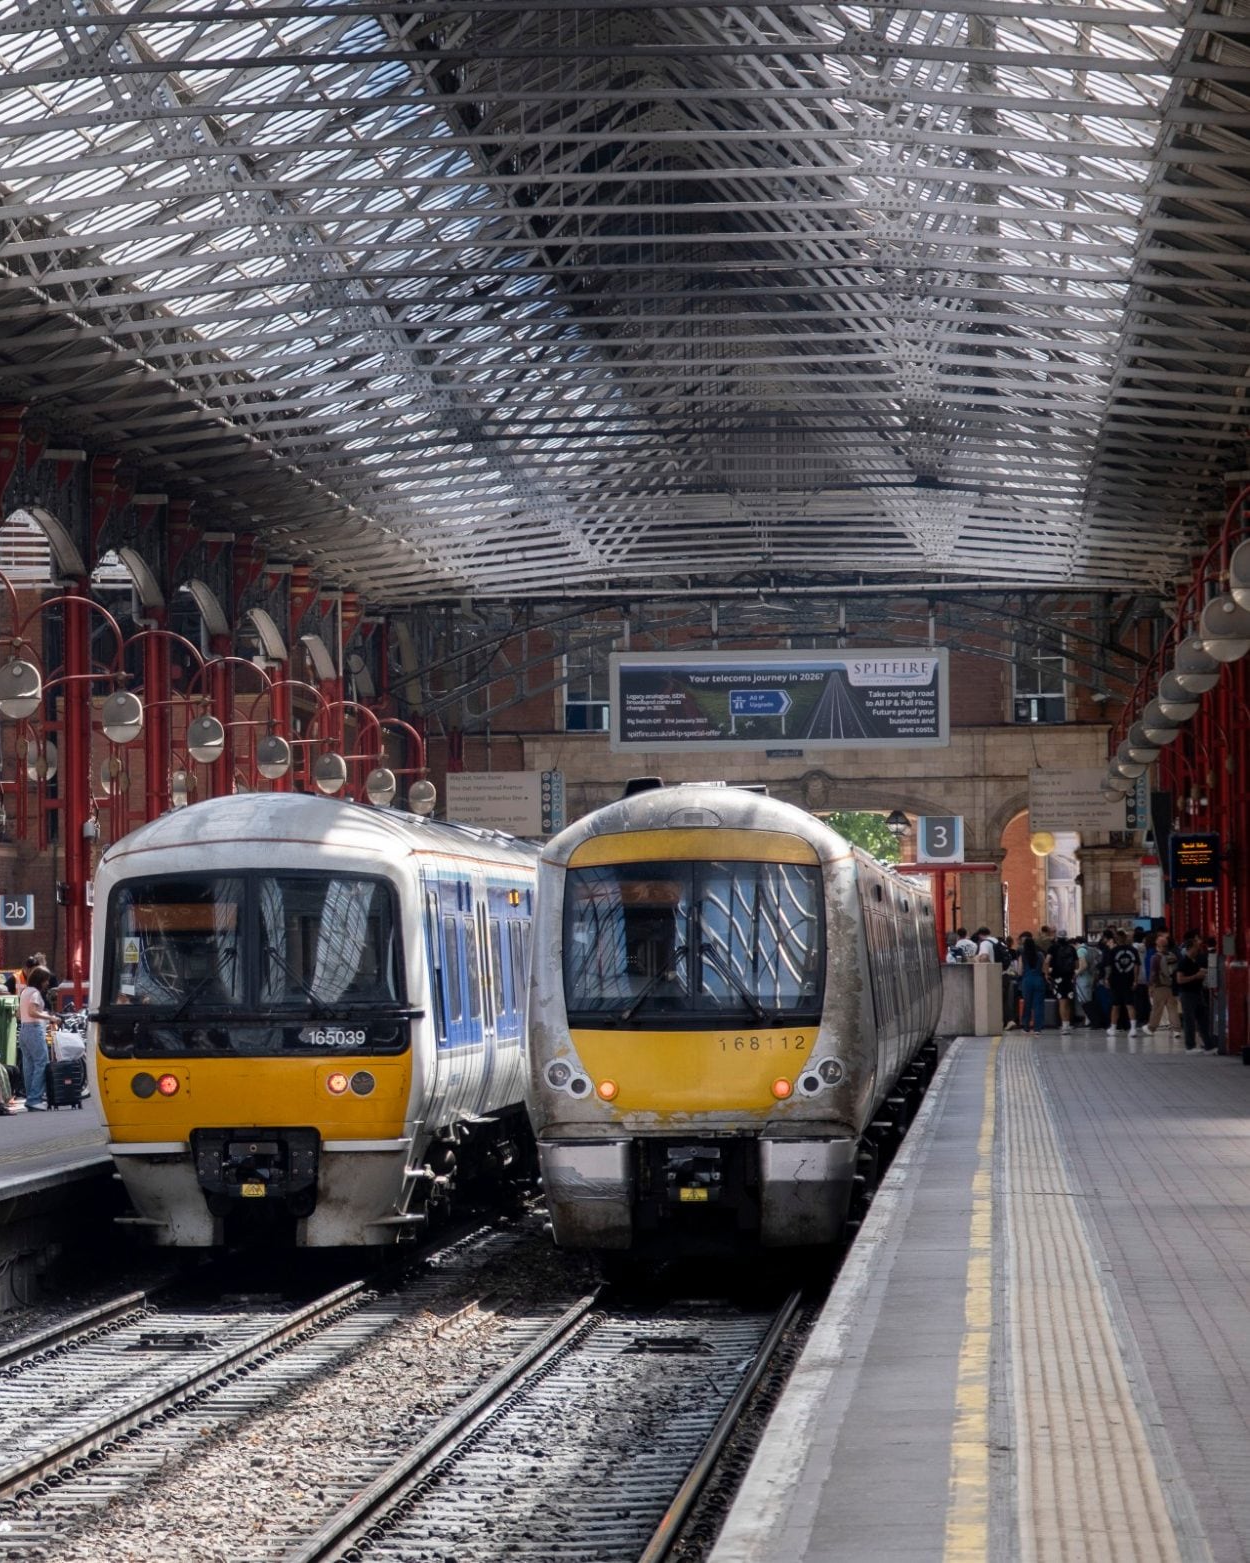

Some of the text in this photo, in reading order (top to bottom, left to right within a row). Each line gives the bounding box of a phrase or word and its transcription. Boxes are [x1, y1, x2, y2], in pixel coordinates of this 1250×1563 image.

[854, 662, 930, 674] SPITFIRE
[712, 674, 751, 682] telecoms
[752, 674, 787, 684] journey
[800, 673, 824, 681] 2026?
[900, 690, 916, 698] high
[898, 708, 917, 716] proof
[934, 826, 948, 848] 3
[5, 901, 26, 919] 2b
[308, 1030, 366, 1045] 165039
[719, 1036, 805, 1051] 168112
